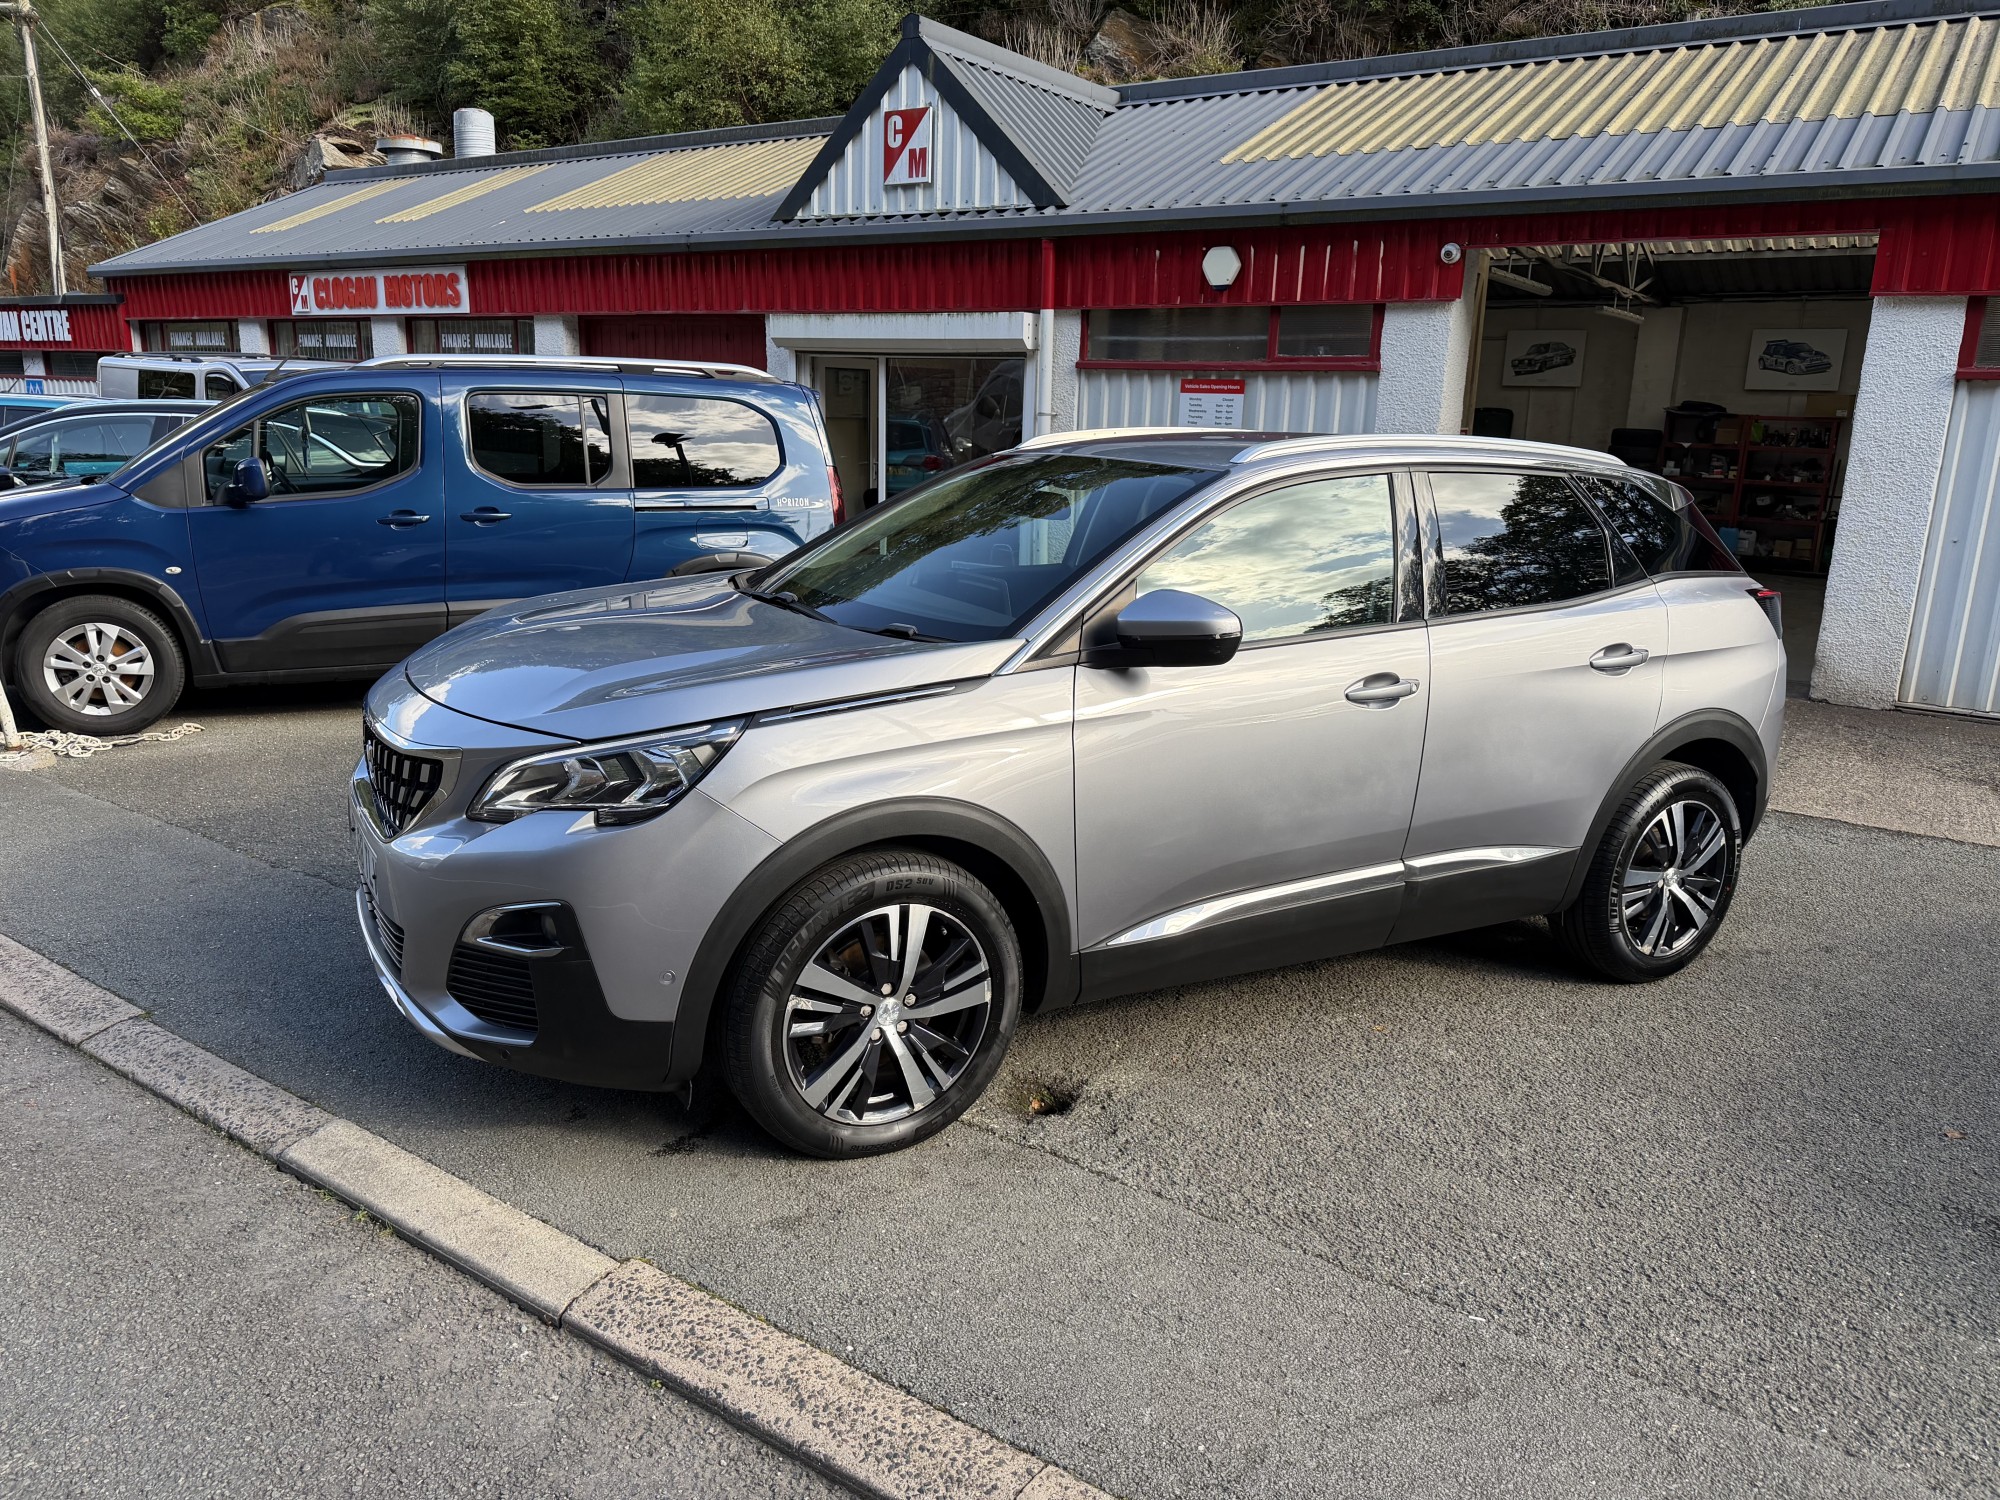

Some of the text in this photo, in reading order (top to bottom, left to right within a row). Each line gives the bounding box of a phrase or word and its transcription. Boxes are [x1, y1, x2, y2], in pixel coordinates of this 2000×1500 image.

[887, 115, 903, 149] C
[908, 147, 927, 178] M
[291, 277, 299, 295] C
[313, 273, 461, 310] CLOGAU MOTORS
[301, 294, 309, 310] M
[20, 309, 72, 342] CENTRE
[170, 331, 226, 346] FINANCE AVAILABLE
[298, 333, 357, 348] FINANCE AVAILABLE
[441, 333, 513, 349] FINANCE AVAILABLE
[777, 496, 810, 508] HORIZON
[885, 877, 934, 892] DS2 SUV
